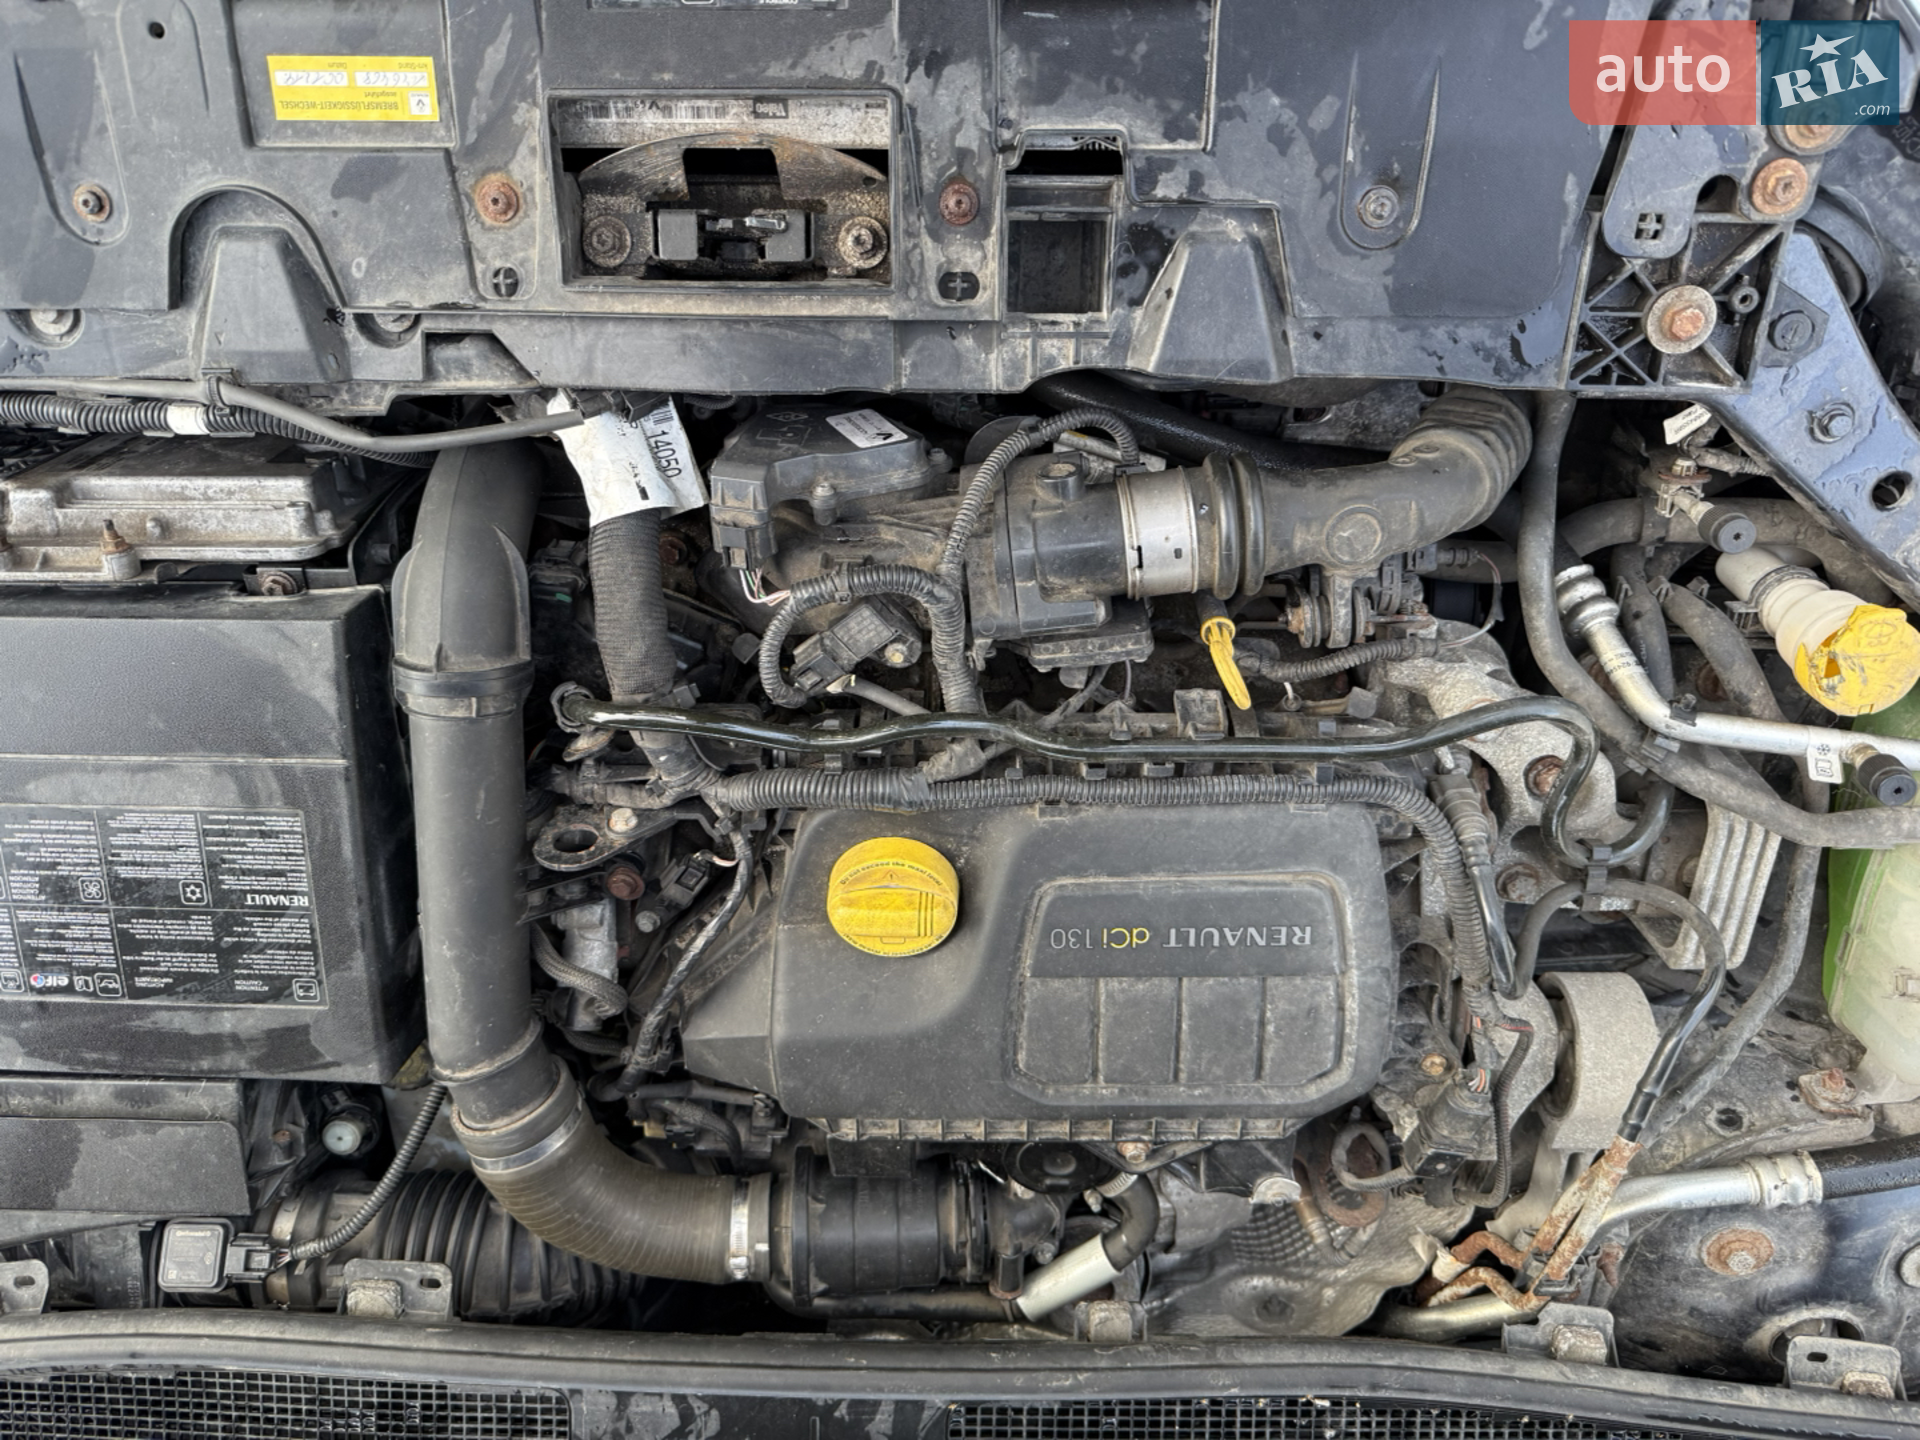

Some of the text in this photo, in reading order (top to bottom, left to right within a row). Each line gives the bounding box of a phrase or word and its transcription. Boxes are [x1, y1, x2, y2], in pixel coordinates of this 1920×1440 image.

[280, 100, 398, 111] BREMSFLÜSSIGKEIT-WECHSEL
[756, 102, 786, 117] Valeo
[647, 430, 682, 478] 14050
[246, 893, 309, 907] RENAULT
[1050, 925, 1312, 949] RENAULT dCi 130
[45, 976, 69, 987] elf
